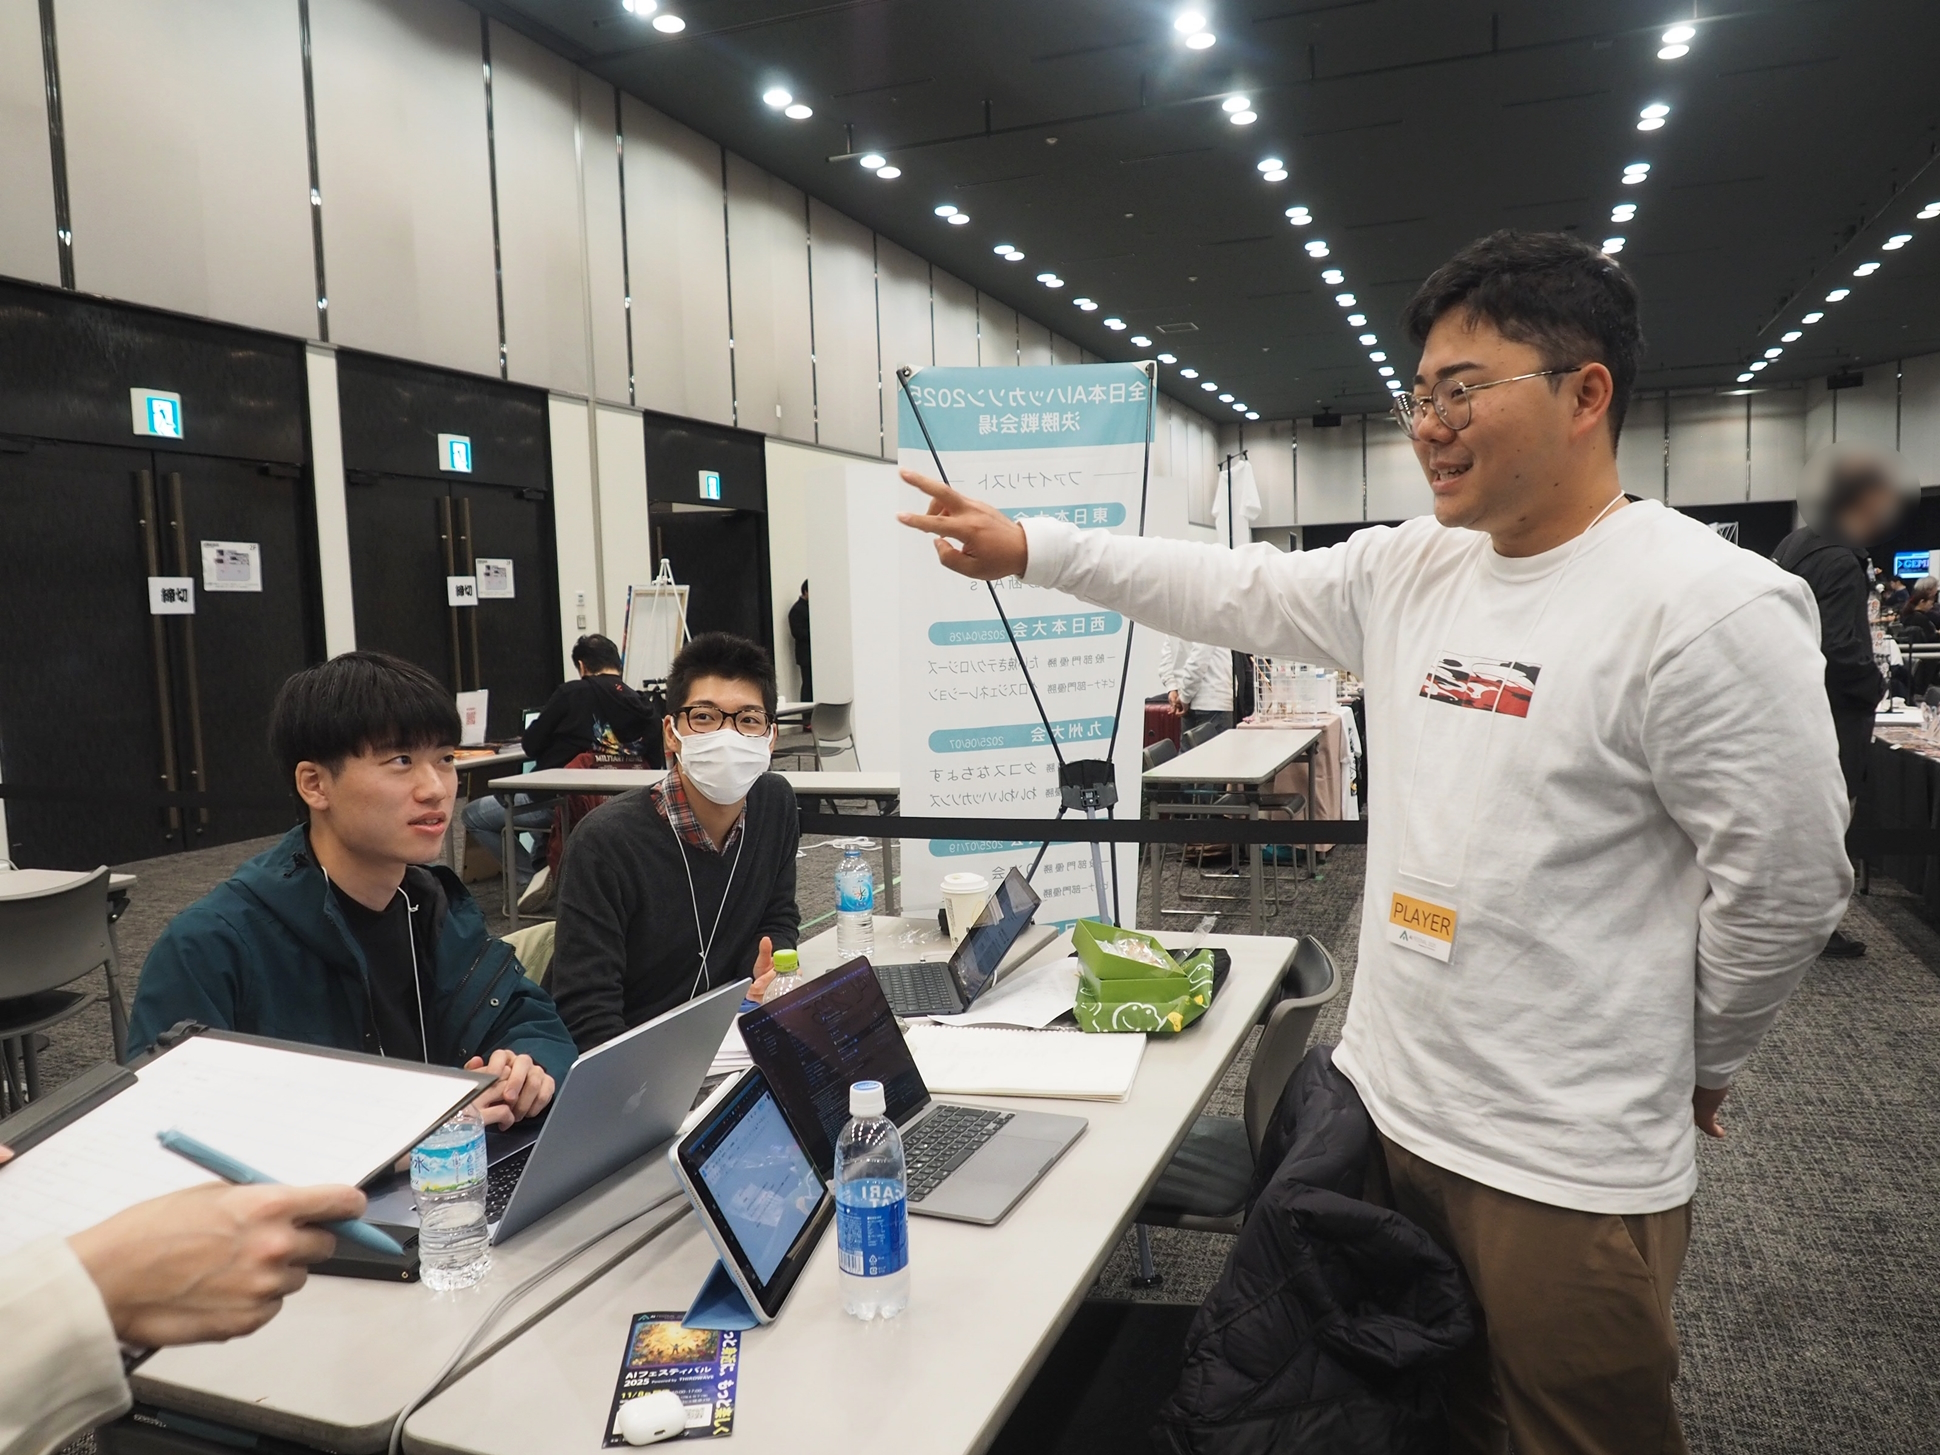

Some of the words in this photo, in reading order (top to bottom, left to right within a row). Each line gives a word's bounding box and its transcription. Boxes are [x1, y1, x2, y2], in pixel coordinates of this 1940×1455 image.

[1394, 902, 1450, 936] PLAYER
[625, 1366, 712, 1380] AIフェスティバル
[623, 1378, 650, 1388] 2025
